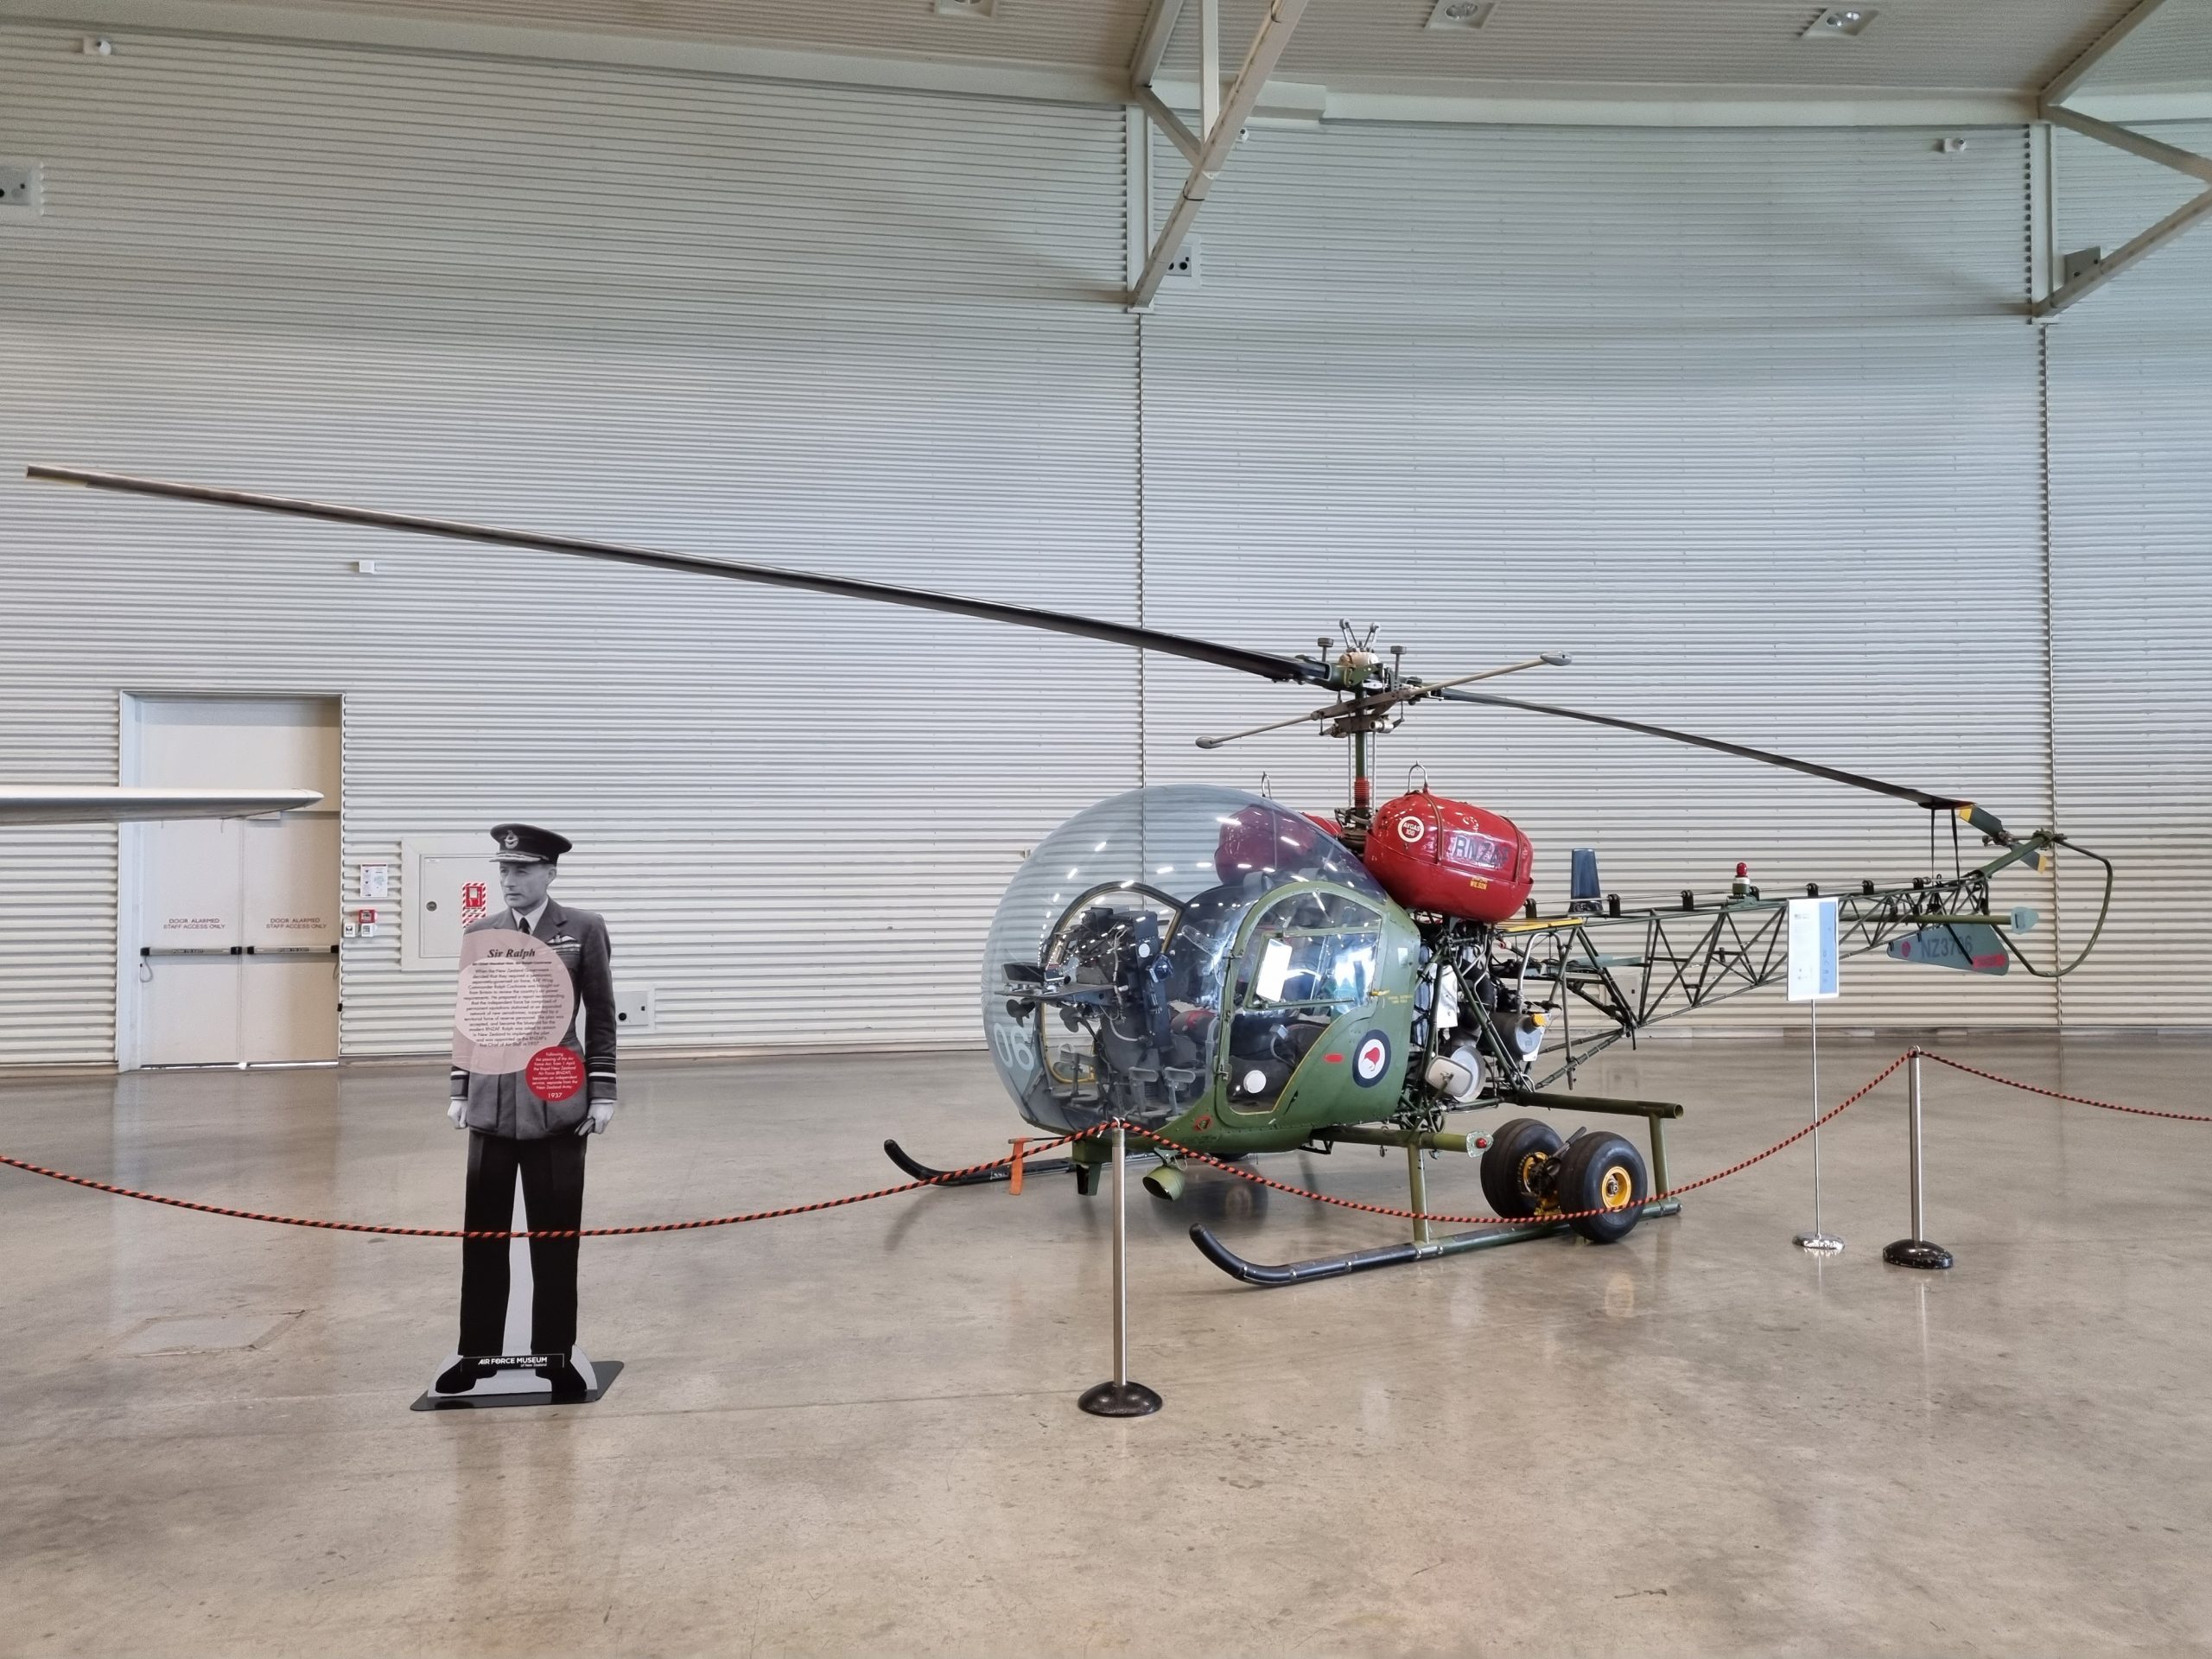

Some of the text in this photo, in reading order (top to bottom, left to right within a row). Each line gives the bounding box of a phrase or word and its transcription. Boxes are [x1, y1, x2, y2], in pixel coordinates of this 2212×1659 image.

[1403, 822, 1421, 832] AVGAS
[1452, 836, 1508, 865] RNZAF
[487, 949, 535, 959] Sir Ralph
[994, 1023, 1034, 1071] 06
